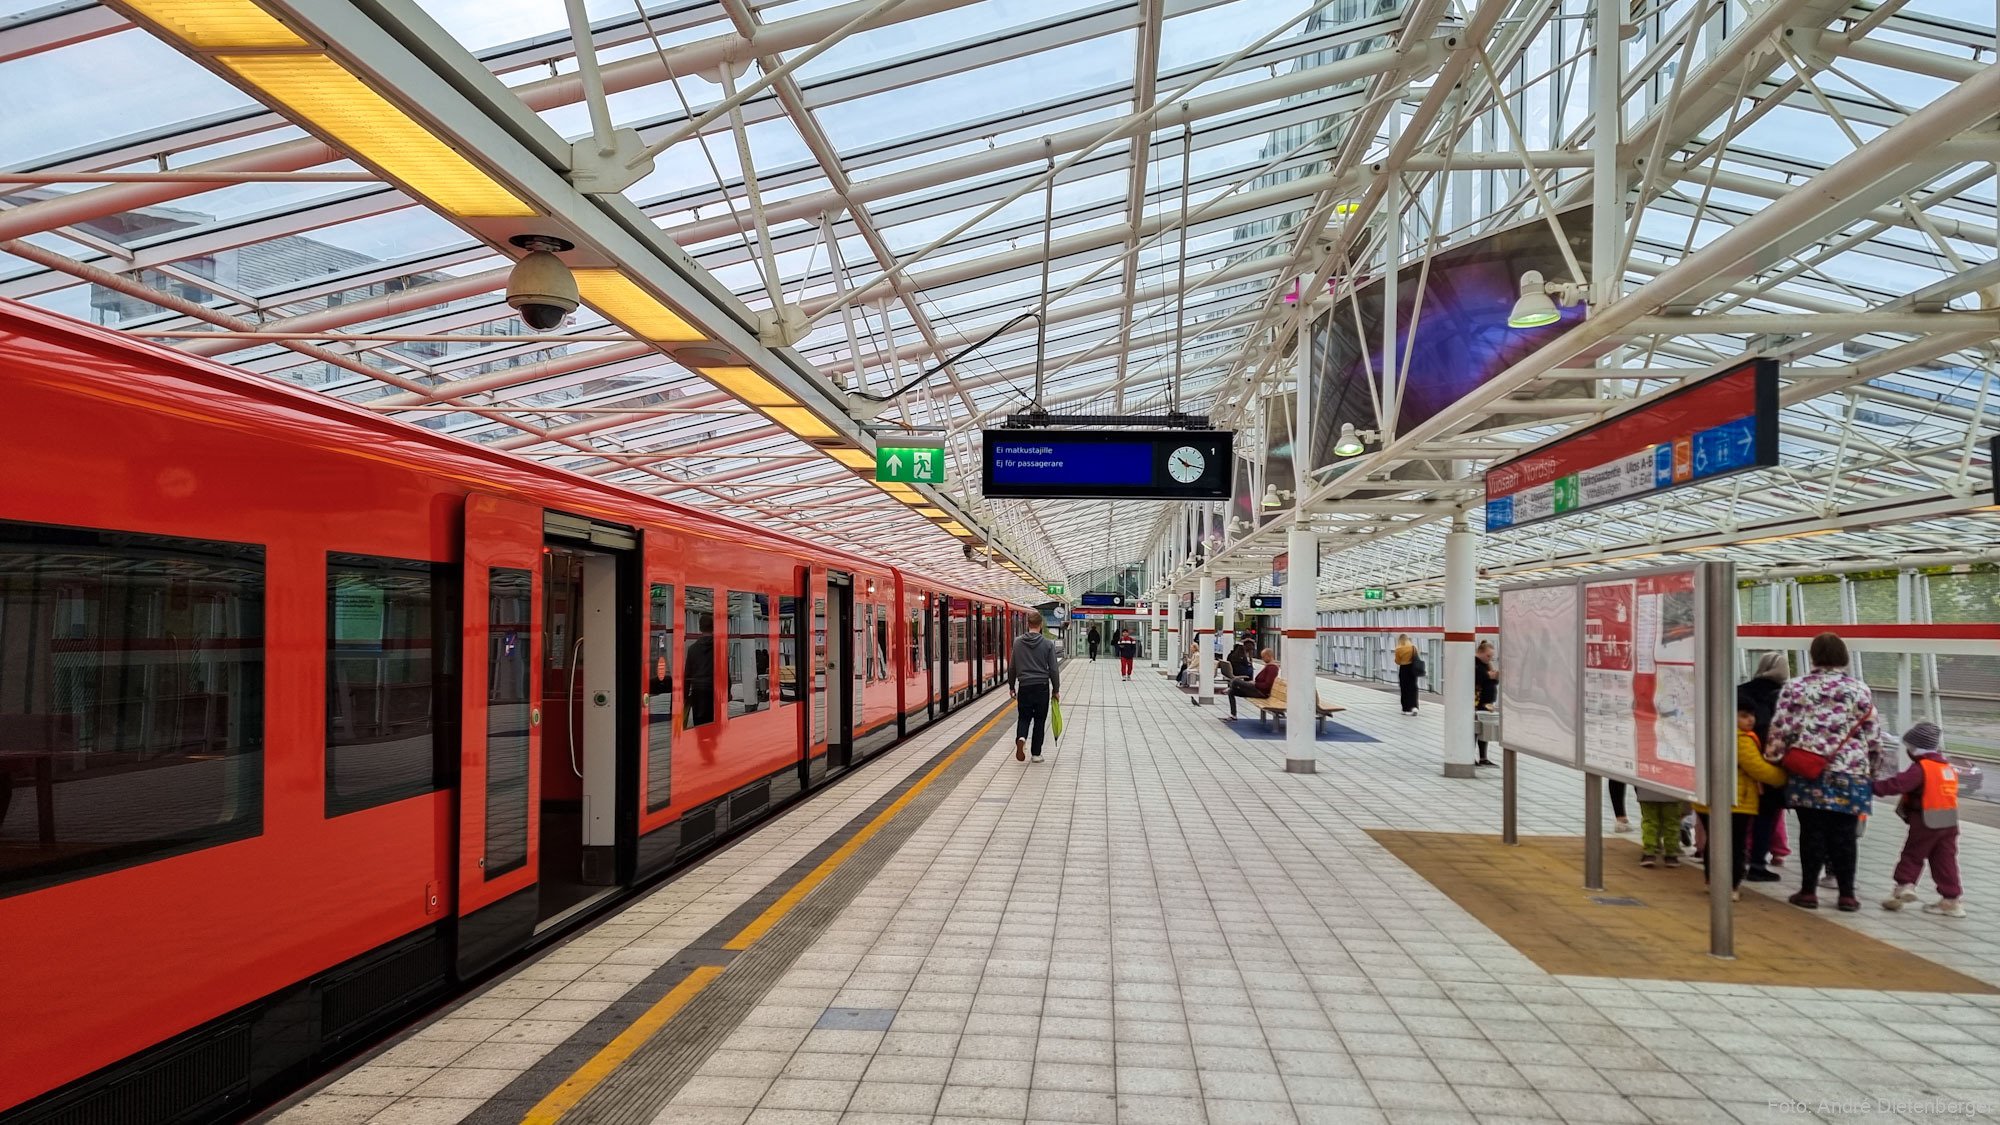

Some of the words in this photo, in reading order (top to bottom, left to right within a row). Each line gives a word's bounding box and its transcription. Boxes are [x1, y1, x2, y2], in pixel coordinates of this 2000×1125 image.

[996, 446, 1003, 454] Ei
[1005, 446, 1053, 455] matkustajille
[1210, 447, 1216, 455] 1
[996, 460, 1004, 469] Ej
[1005, 459, 1016, 468] för
[1017, 461, 1064, 469] passagerare
